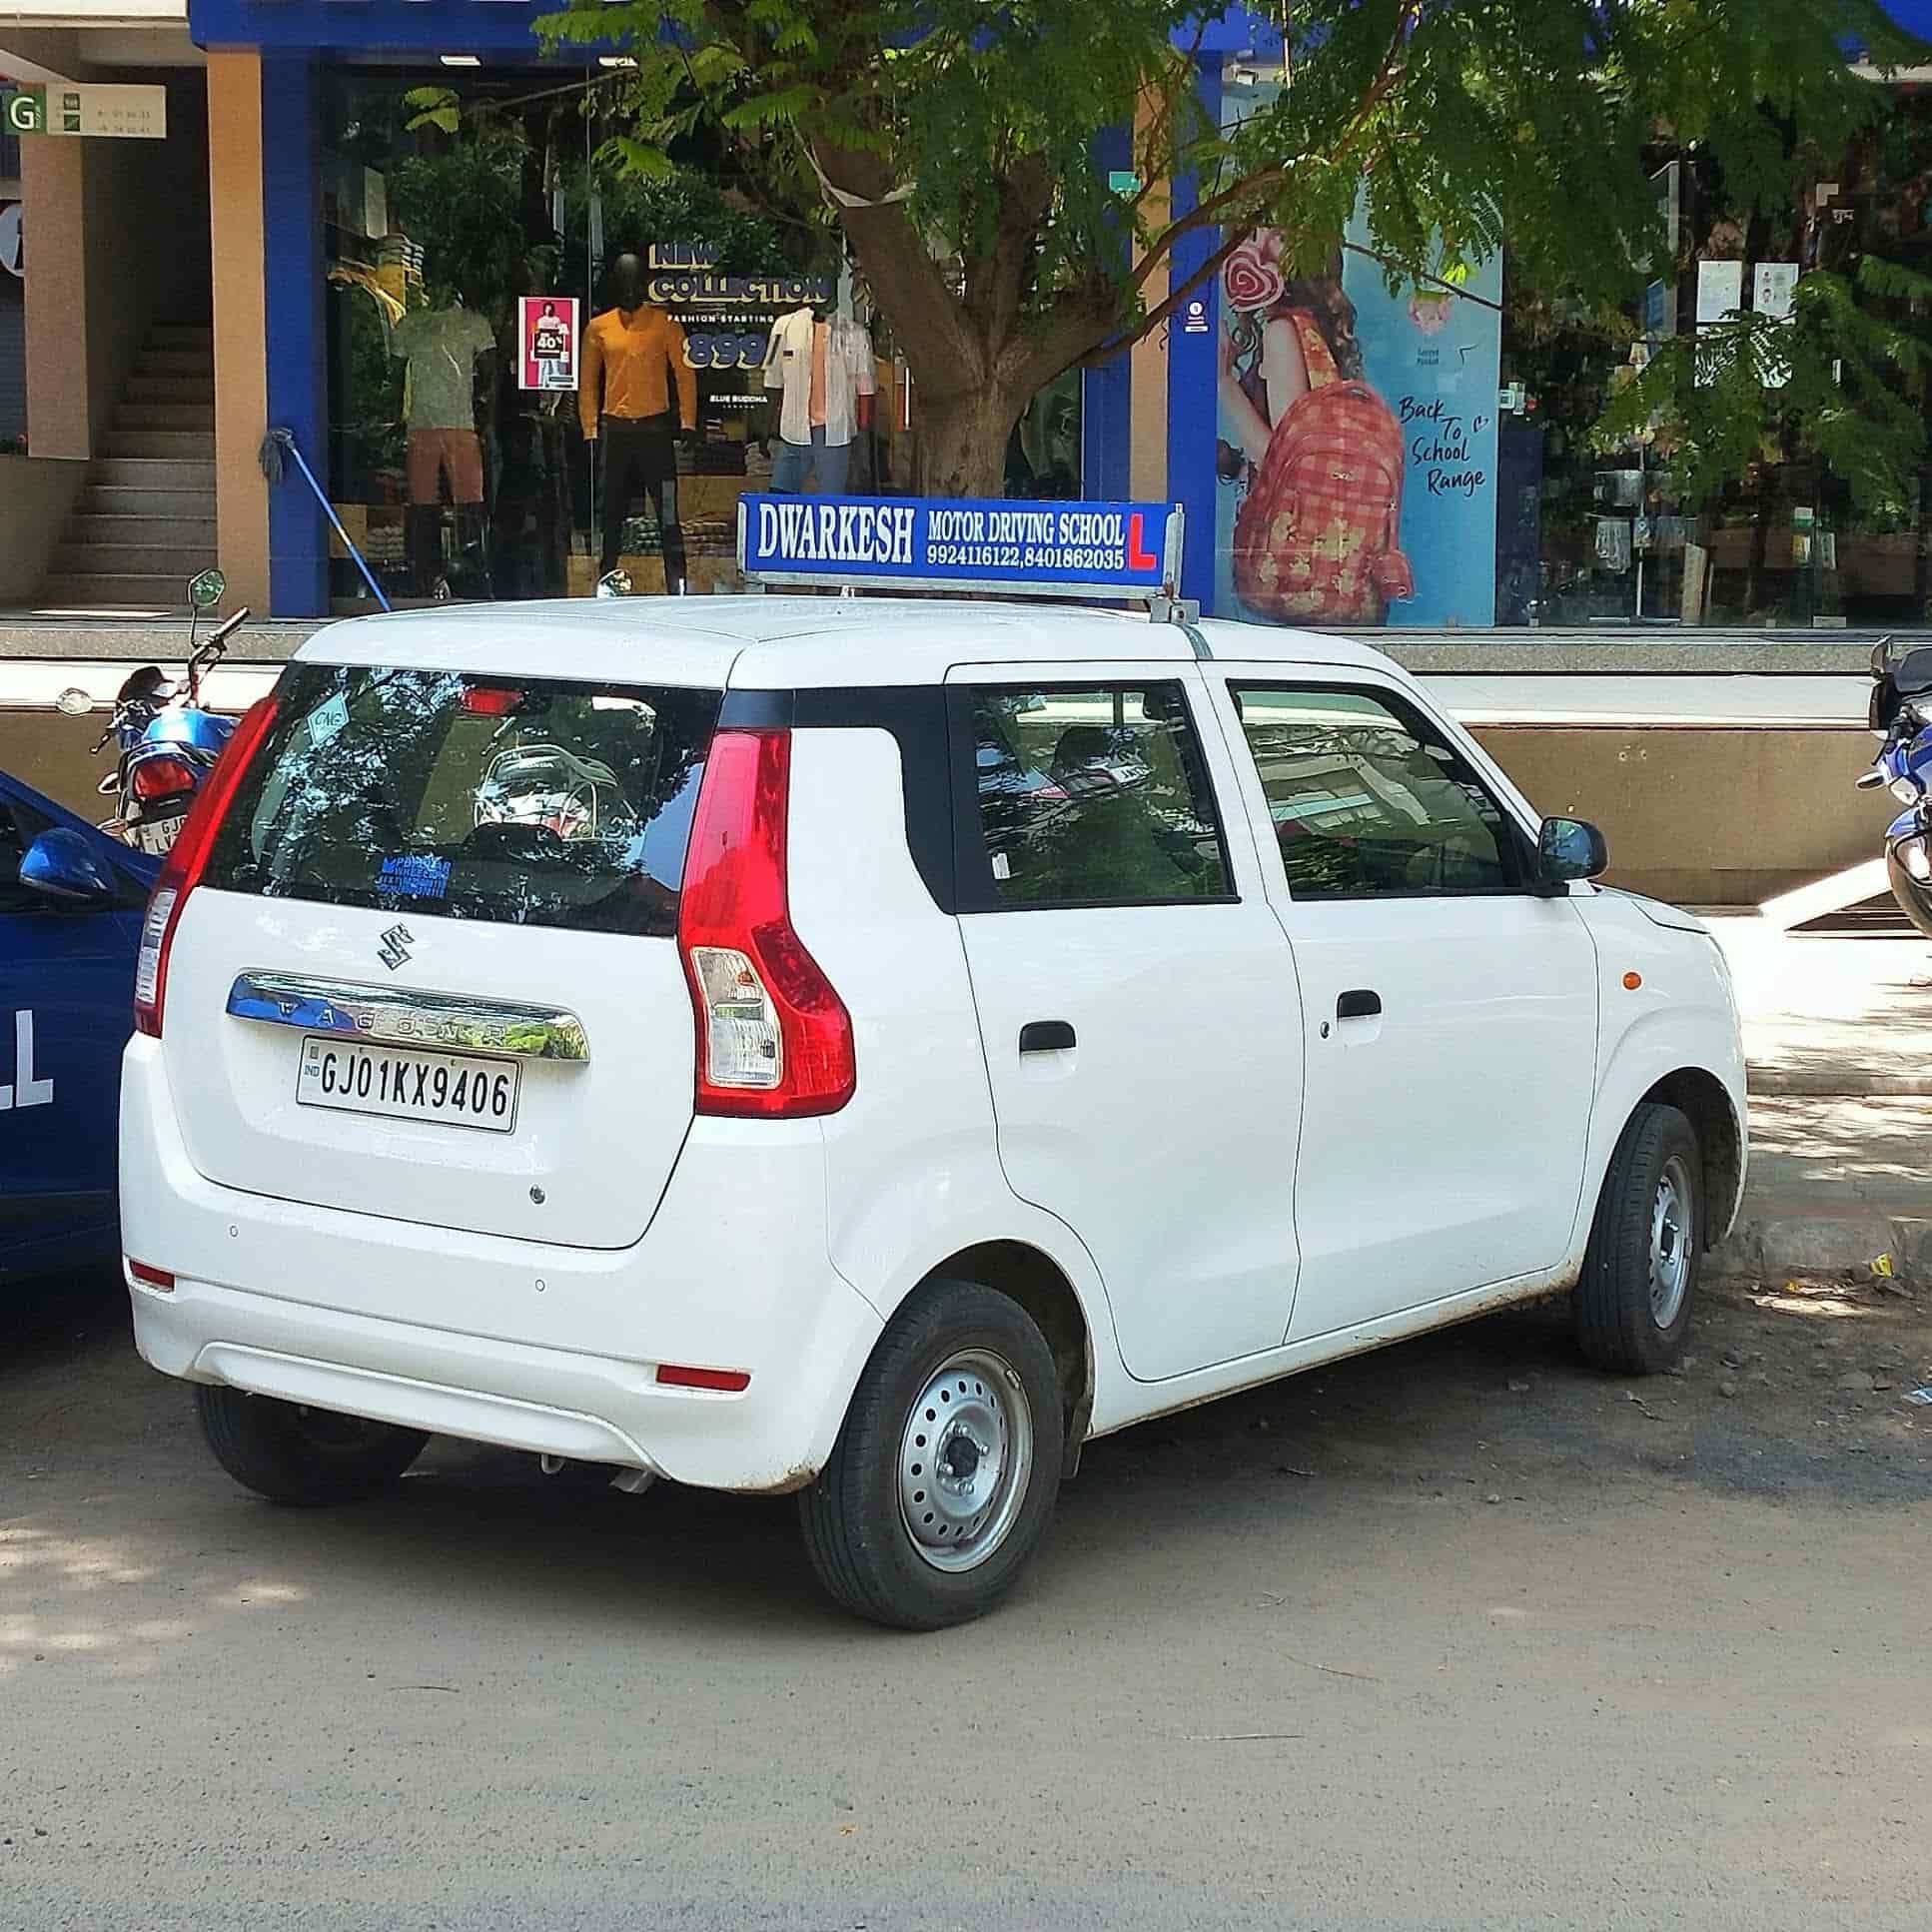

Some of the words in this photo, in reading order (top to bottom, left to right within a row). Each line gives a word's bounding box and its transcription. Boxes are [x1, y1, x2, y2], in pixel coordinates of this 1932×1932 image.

[10, 96, 35, 130] G
[648, 241, 719, 270] NEW
[648, 274, 830, 304] COLLECTION
[666, 314, 716, 324] FASHION
[719, 314, 775, 324] STARTING
[1399, 395, 1446, 425] Back
[1441, 417, 1462, 441] To
[1412, 437, 1471, 466] School
[1427, 468, 1486, 497] Range
[757, 502, 916, 564] DWARKESH
[927, 510, 984, 542] MOTOR
[987, 511, 1055, 545] DRIVING
[1058, 512, 1126, 546] SCHOOL
[1128, 512, 1158, 570] L
[0, 1009, 54, 1111] L
[304, 1064, 321, 1077] IND
[321, 1052, 509, 1116] GJ01KX9406
